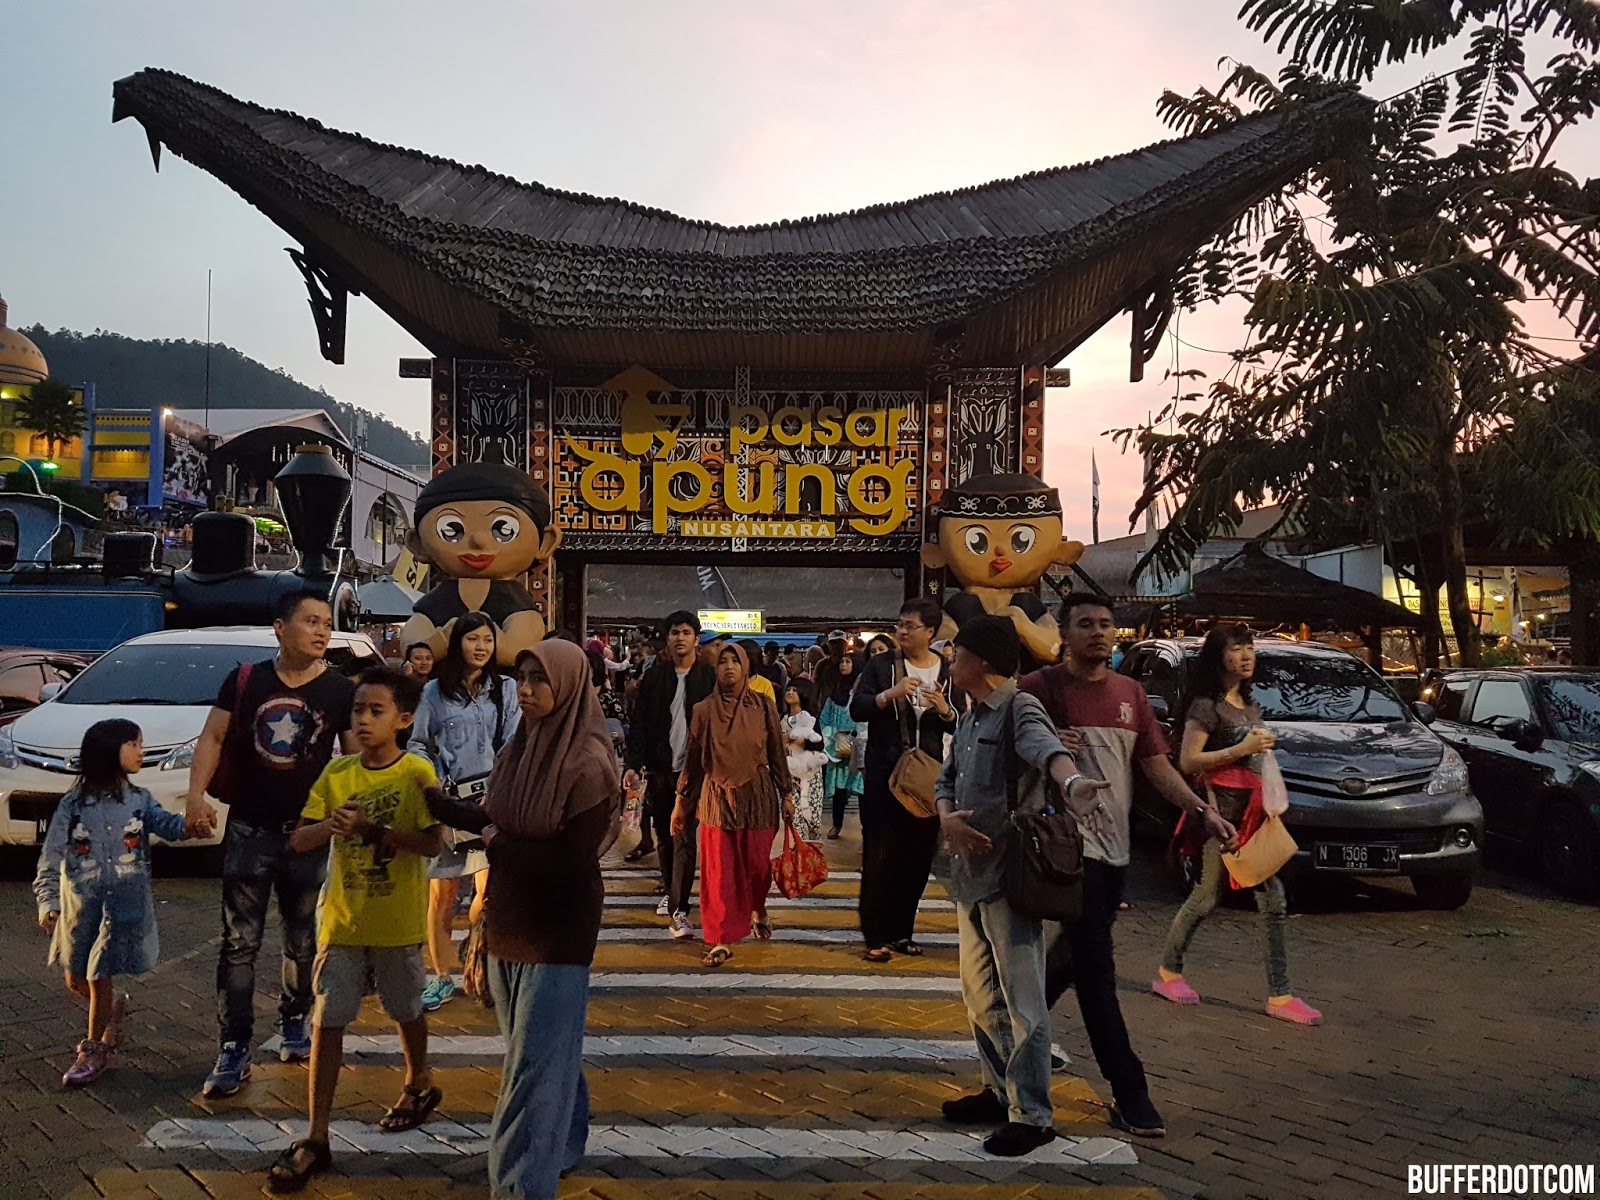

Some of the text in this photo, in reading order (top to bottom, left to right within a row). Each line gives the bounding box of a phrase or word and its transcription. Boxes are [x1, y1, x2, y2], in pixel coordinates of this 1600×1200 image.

[729, 403, 907, 455] pasar
[577, 450, 915, 536] apung
[684, 522, 831, 538] NUSANTARA
[1319, 845, 1398, 862] N 1506 JX
